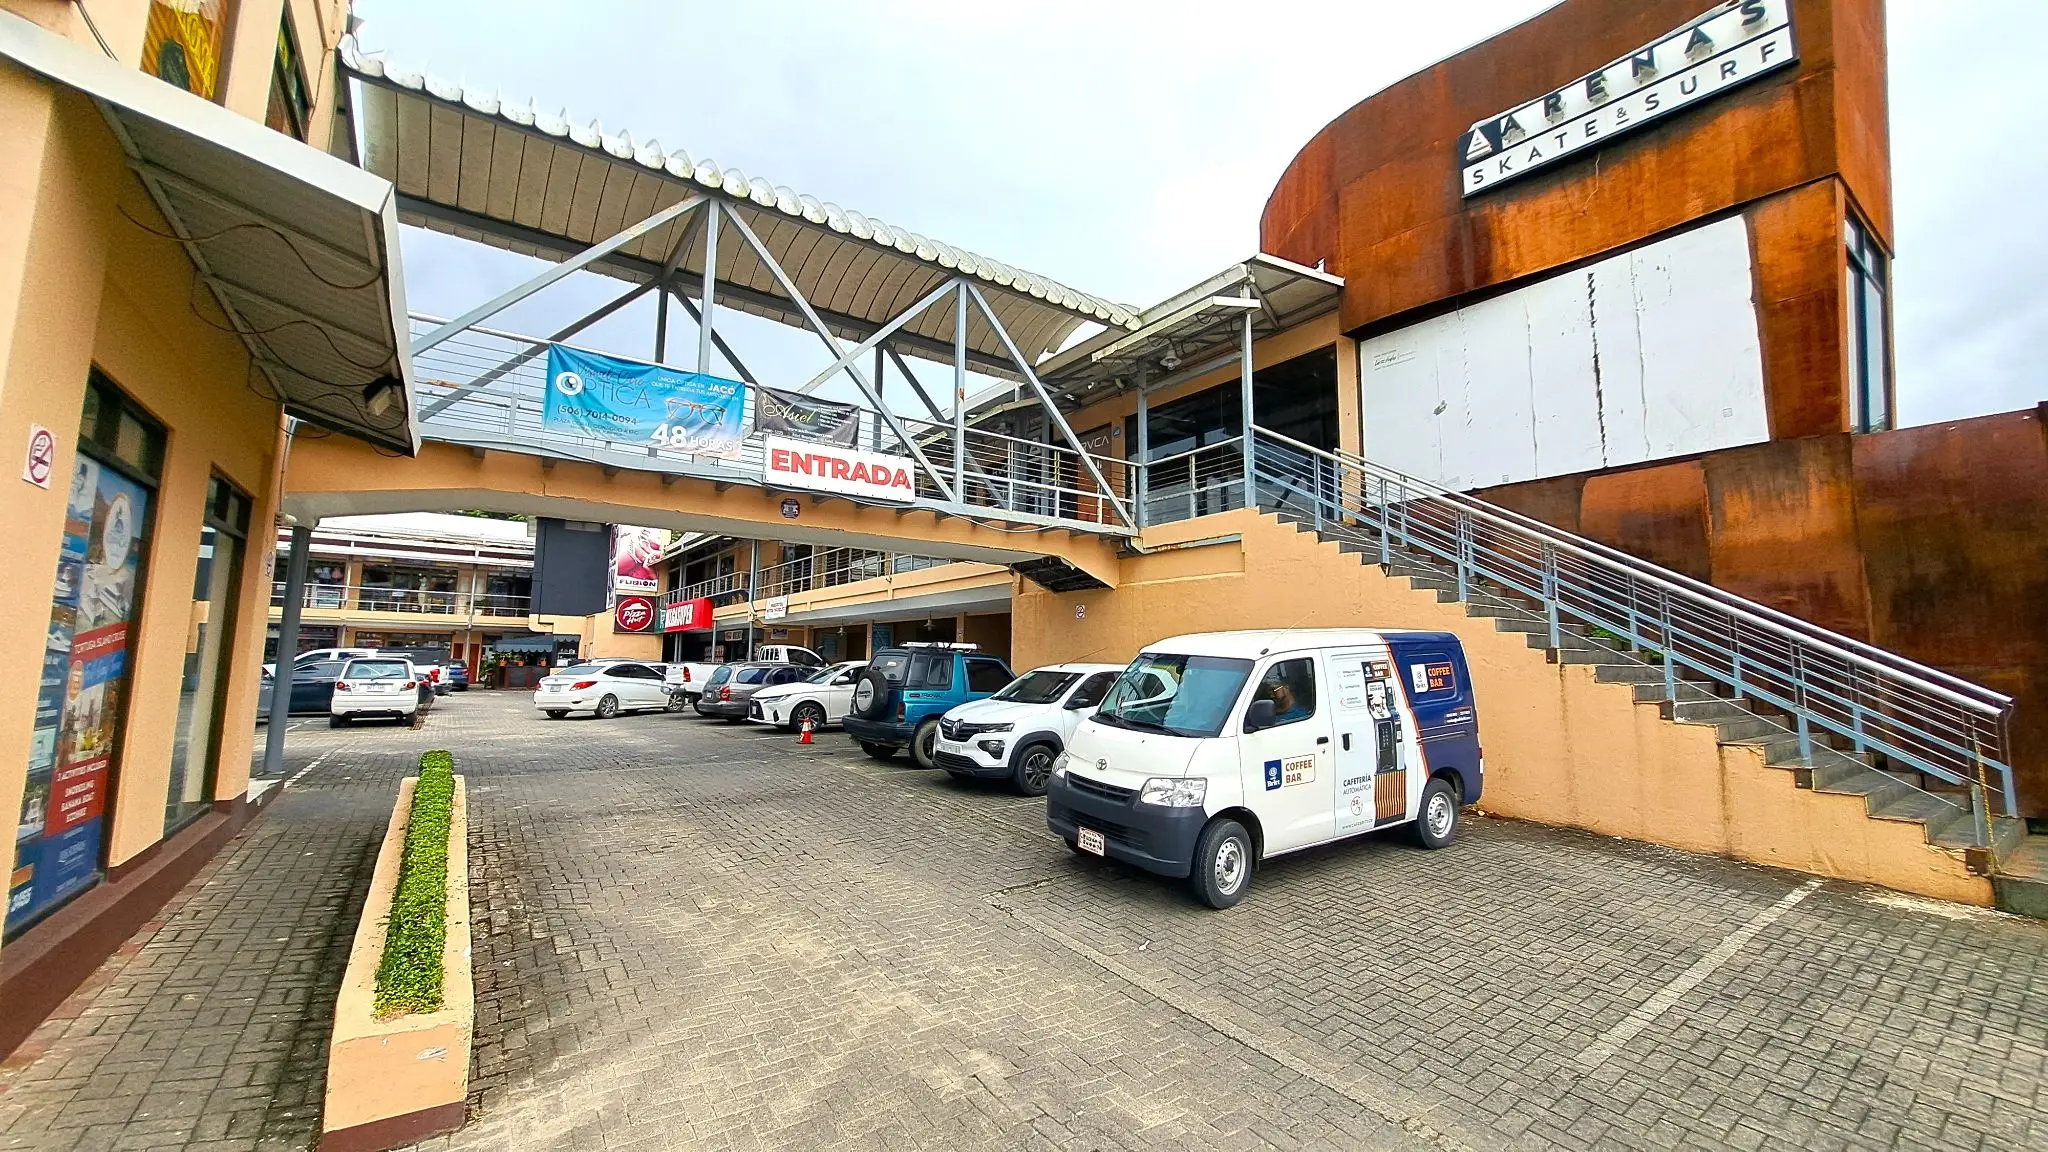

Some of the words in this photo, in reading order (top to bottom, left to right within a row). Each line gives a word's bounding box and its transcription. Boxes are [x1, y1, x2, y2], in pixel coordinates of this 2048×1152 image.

[1501, 0, 1767, 138] ARENAS
[1472, 118, 1599, 185] SKATE
[1616, 107, 1630, 121] &
[1644, 40, 1777, 112] SURF
[708, 383, 736, 395] JACÓ
[557, 404, 583, 418] (506)
[650, 423, 687, 447] 48
[689, 435, 734, 451] HORAS
[771, 448, 912, 490] ENTRADA
[623, 610, 646, 620] Pizza
[626, 616, 645, 625] Hut
[1428, 667, 1451, 676] COFFEE
[1430, 678, 1444, 688] BAR
[1285, 759, 1313, 771] COFFEE
[1286, 773, 1302, 783] BAR
[1343, 773, 1372, 787] CAFETERÍA
